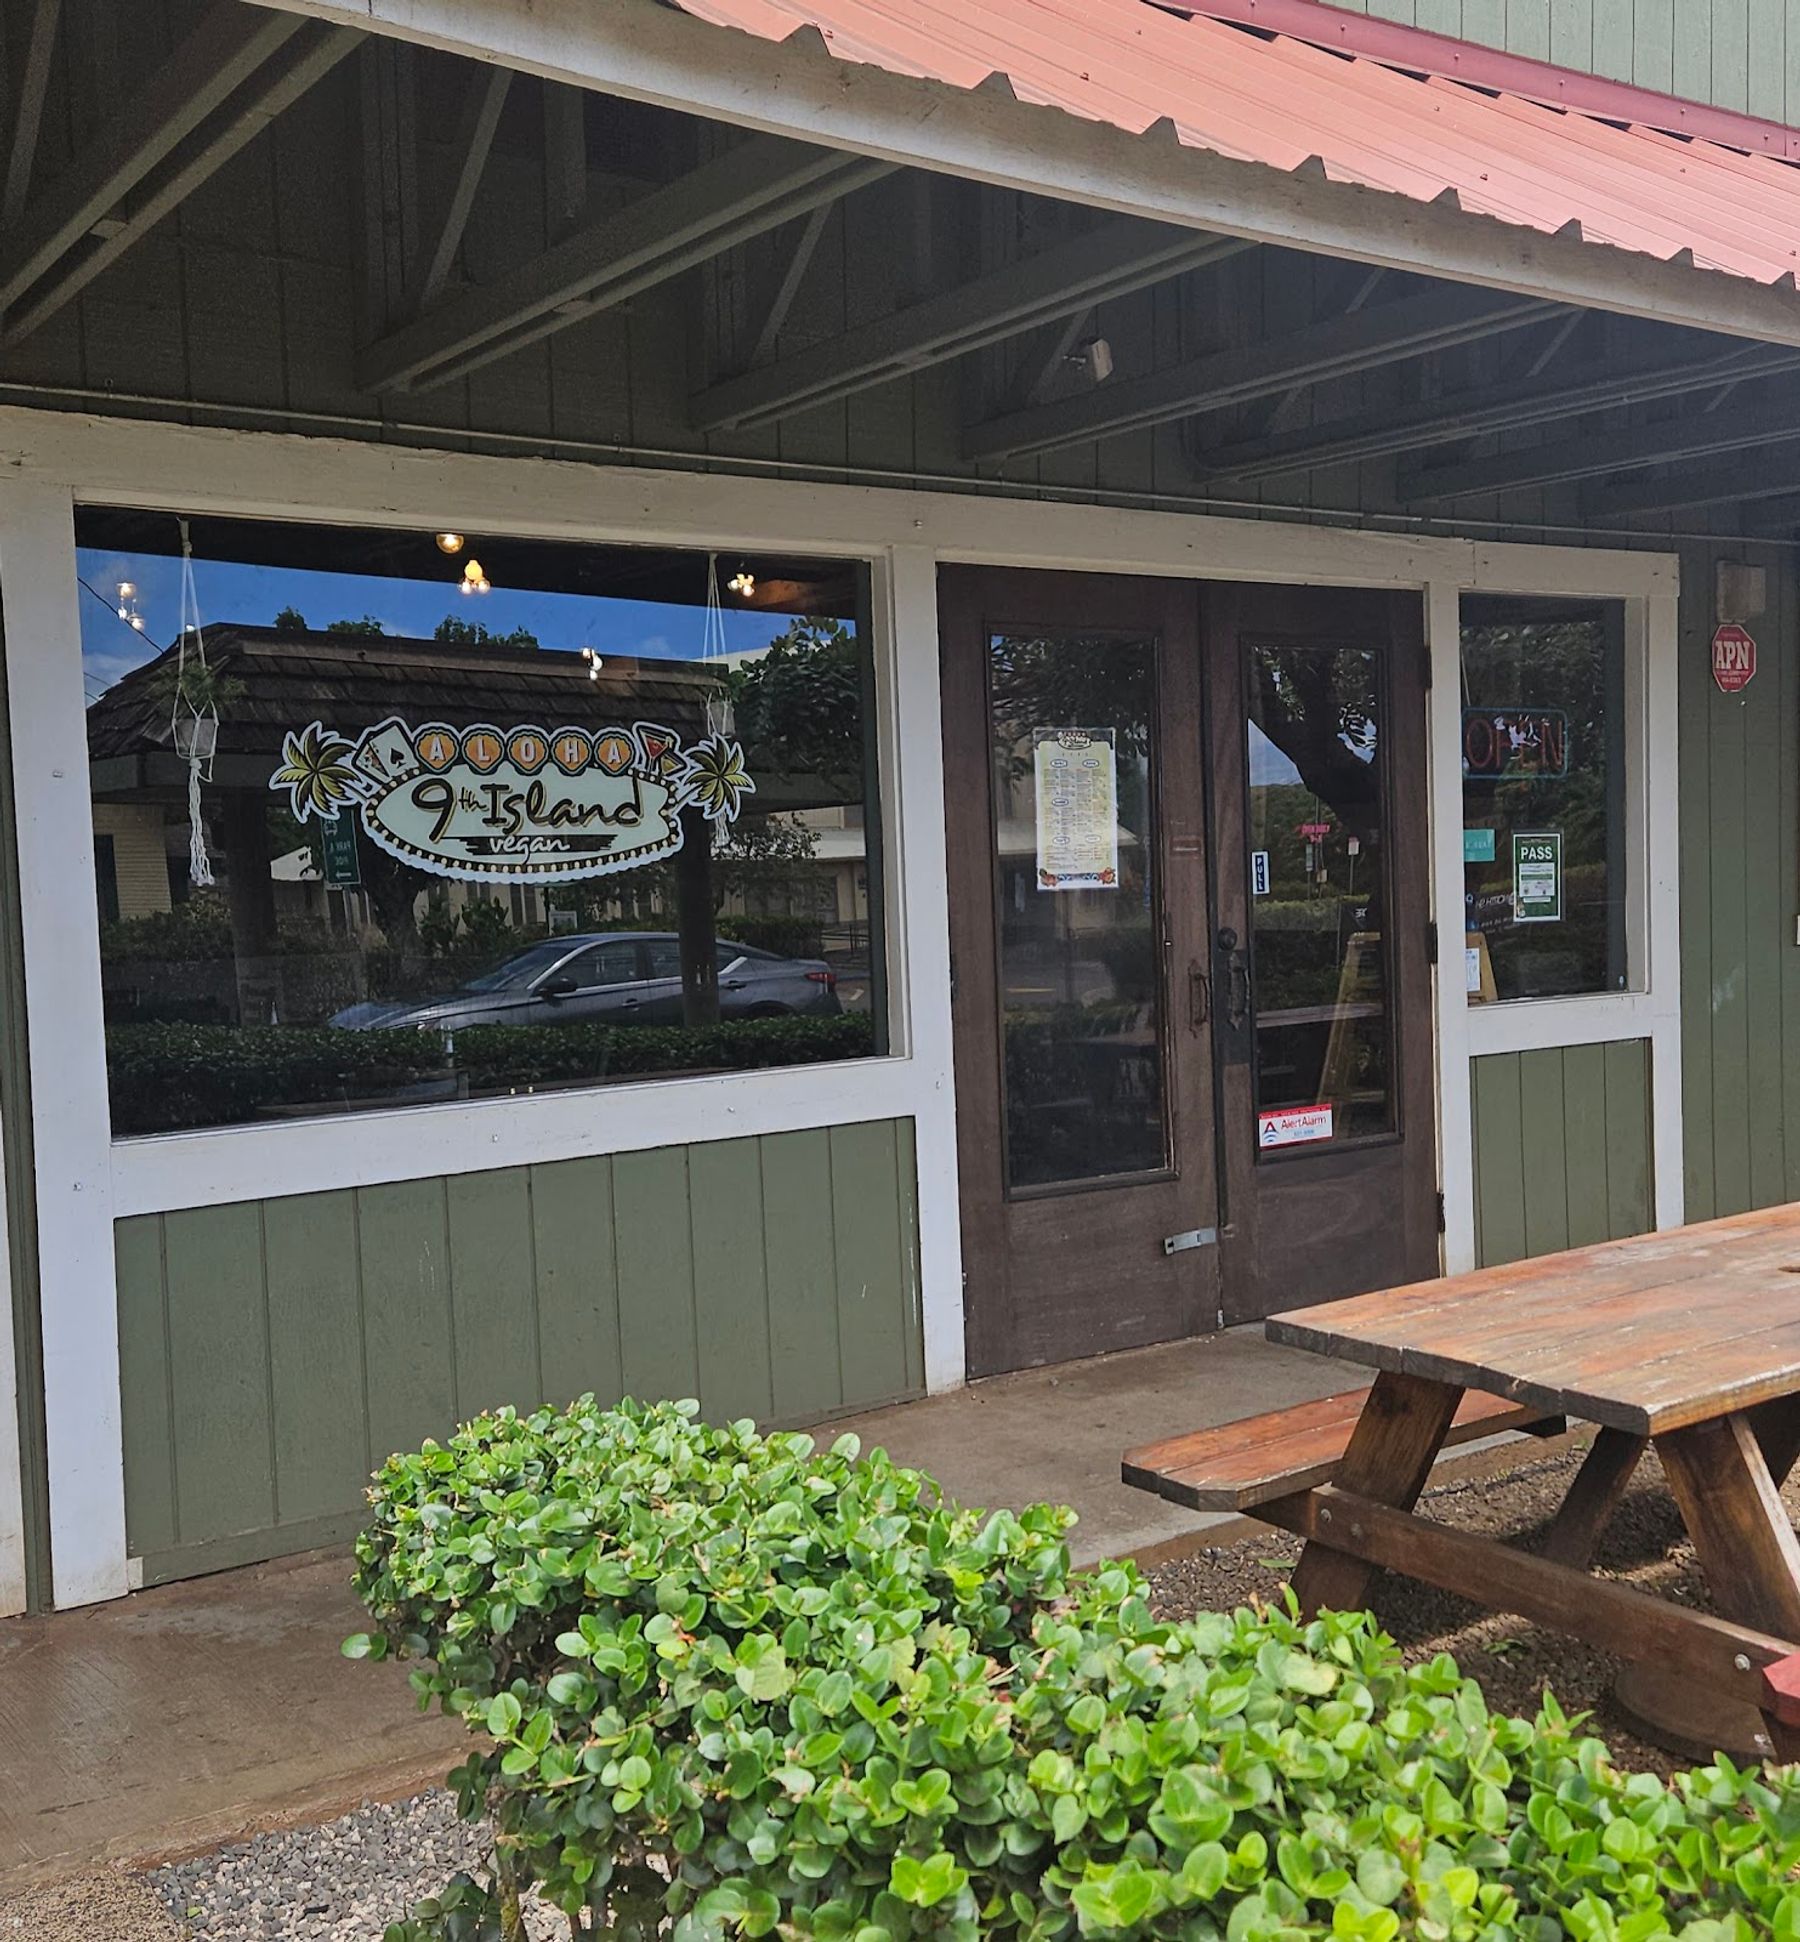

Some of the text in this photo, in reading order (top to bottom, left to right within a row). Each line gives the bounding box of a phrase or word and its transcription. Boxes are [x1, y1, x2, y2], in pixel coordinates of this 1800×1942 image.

[1715, 641, 1750, 669] APN
[429, 731, 621, 764] ALOHA
[1466, 718, 1563, 768] OPEN
[411, 774, 644, 843] 9th Island
[490, 835, 570, 863] vegan
[1520, 846, 1553, 860] PASS
[1256, 855, 1265, 891] PULL
[1281, 1116, 1327, 1129] AlertAlarm
